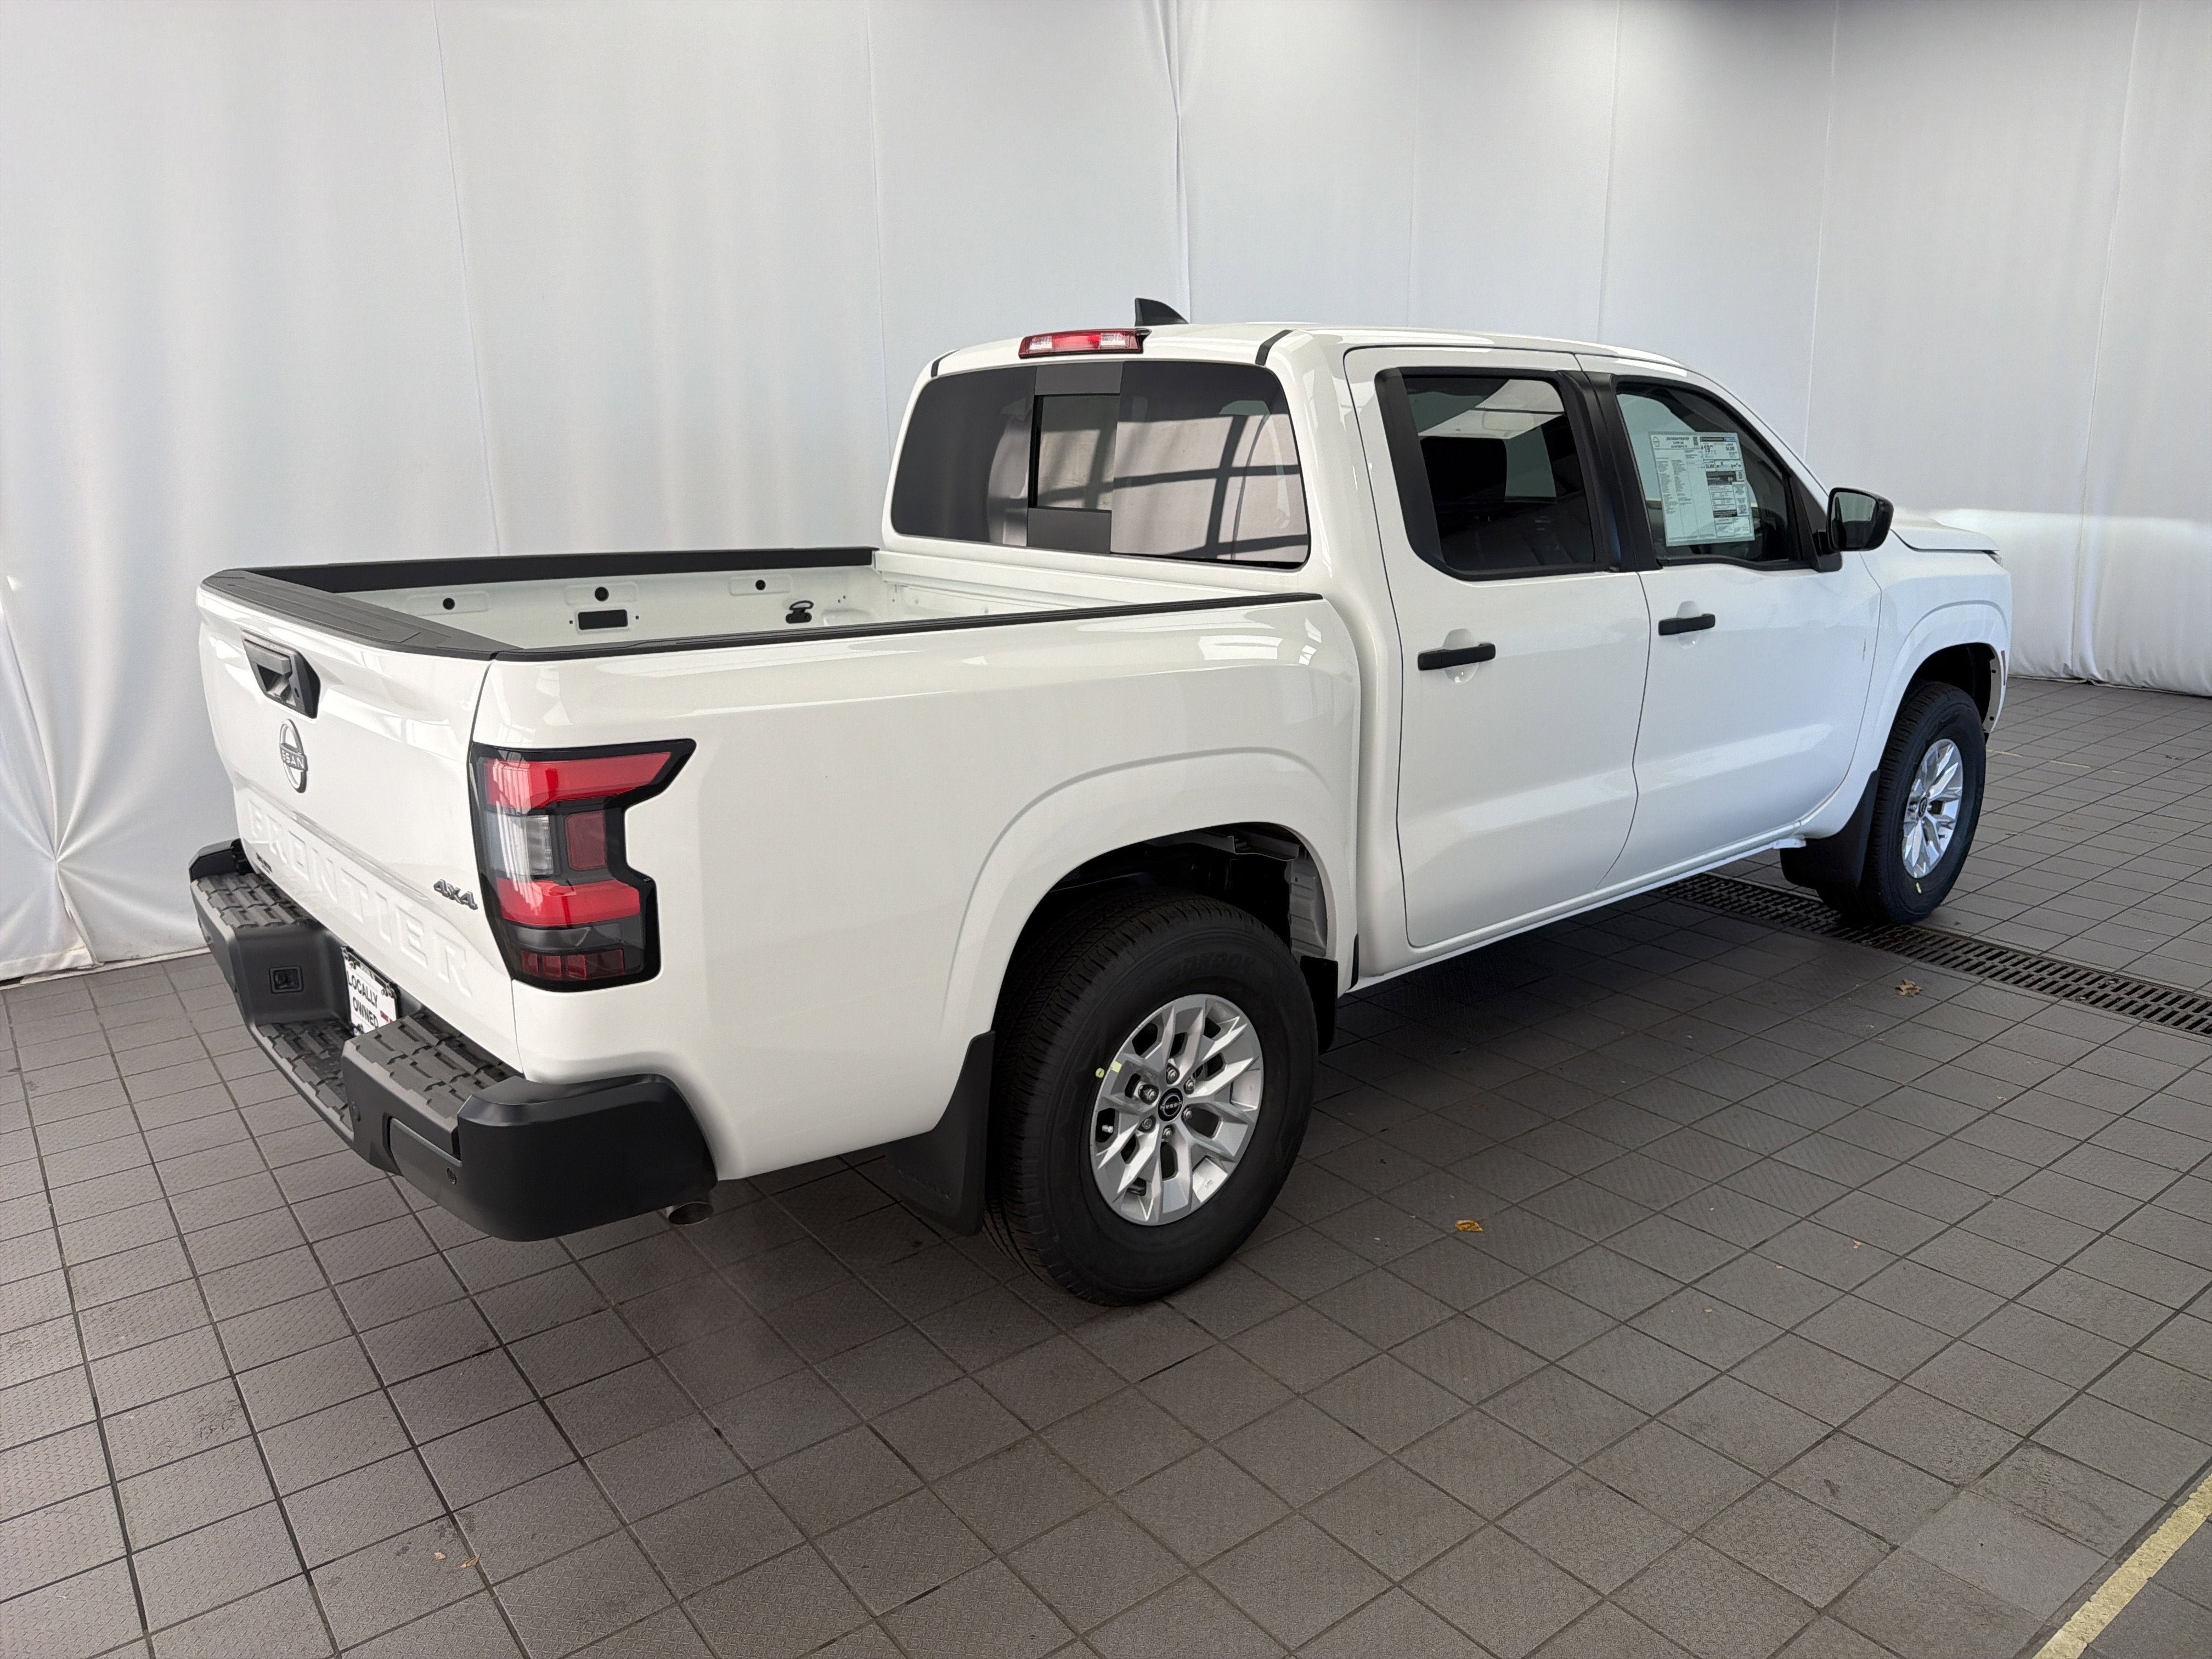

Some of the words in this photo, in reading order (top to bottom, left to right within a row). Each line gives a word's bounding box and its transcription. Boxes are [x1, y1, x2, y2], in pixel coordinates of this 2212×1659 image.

[248, 798, 472, 998] FRONTIER
[346, 970, 378, 1009] LOCALLY
[352, 996, 379, 1029] OWNED
